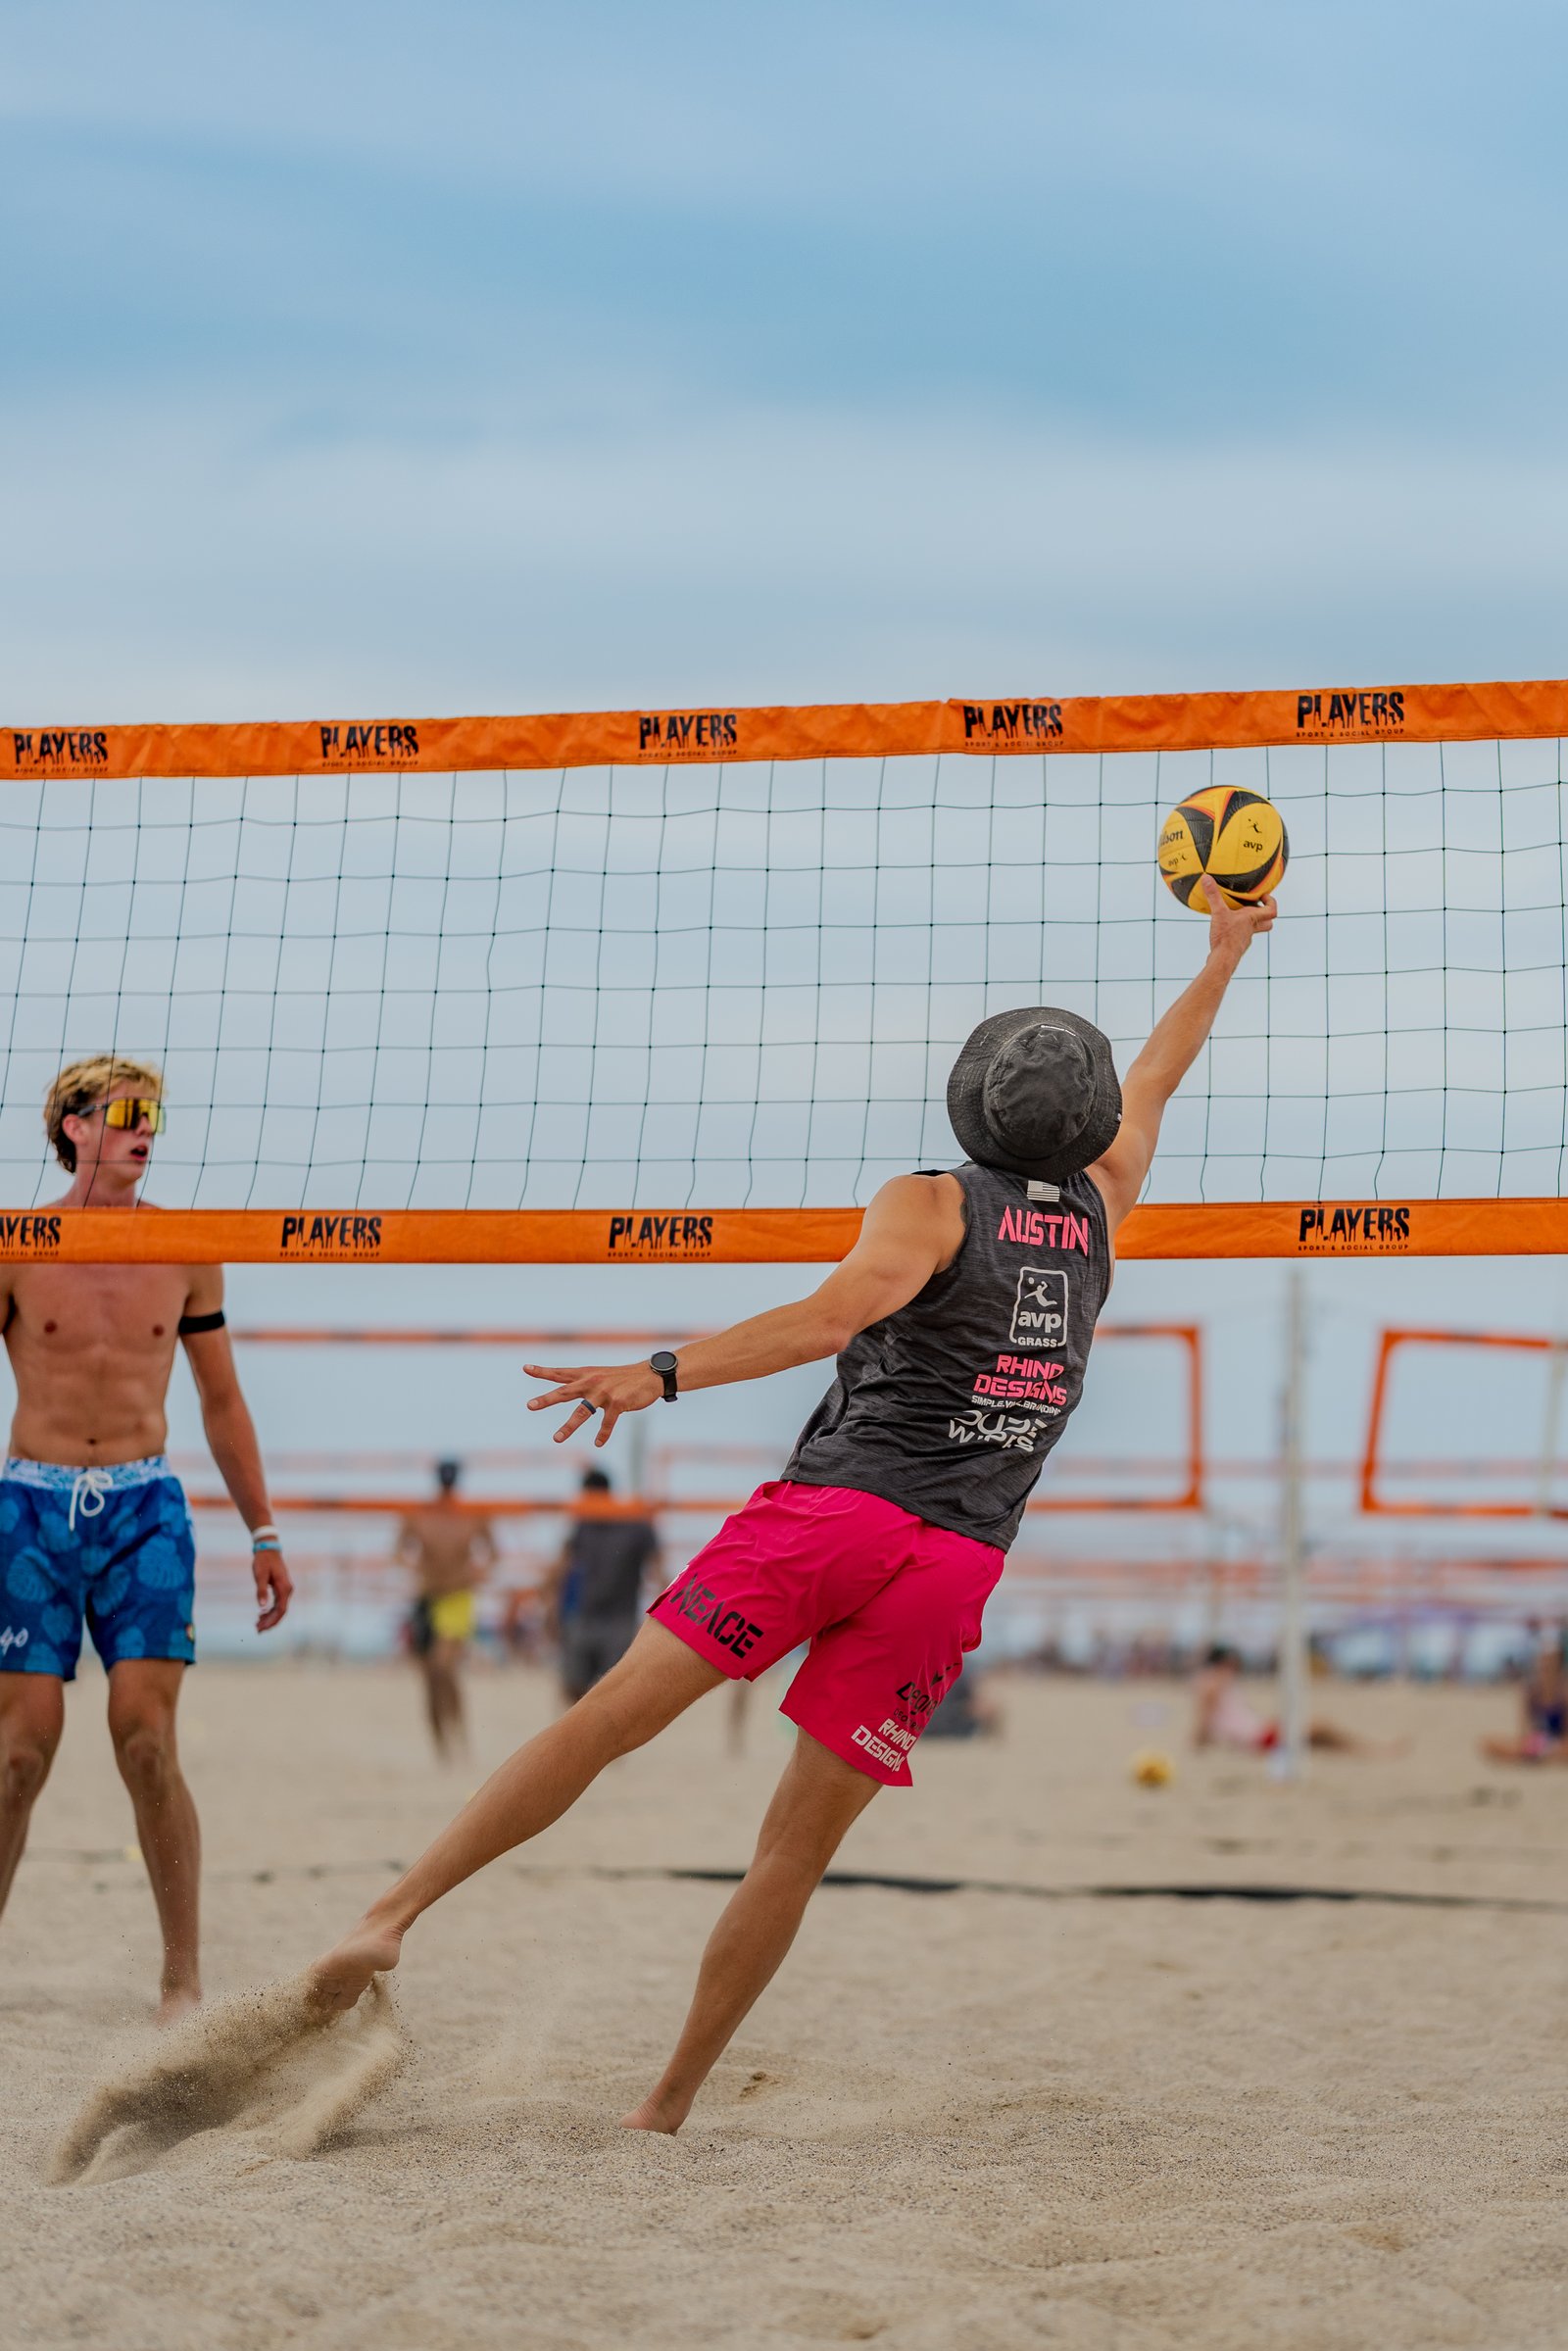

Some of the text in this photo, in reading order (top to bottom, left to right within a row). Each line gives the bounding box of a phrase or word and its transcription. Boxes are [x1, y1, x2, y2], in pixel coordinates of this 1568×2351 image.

[963, 704, 1063, 739] PLAYERS
[1298, 691, 1404, 729] PLAYERS
[14, 731, 108, 764] PLAYERS
[320, 725, 419, 759] PLAYERS
[639, 713, 737, 750] PLAYERS
[1243, 840, 1263, 853] avp
[281, 1216, 382, 1249] PLAYERS
[609, 1216, 713, 1249] PLAYERS
[998, 1204, 1090, 1257] AUSTIN
[1298, 1207, 1410, 1243] PLAYERS
[1018, 1310, 1062, 1334] avp
[1017, 1336, 1057, 1348] GRASS
[669, 1573, 764, 1659] NEACE
[878, 1718, 917, 1751] RHINO
